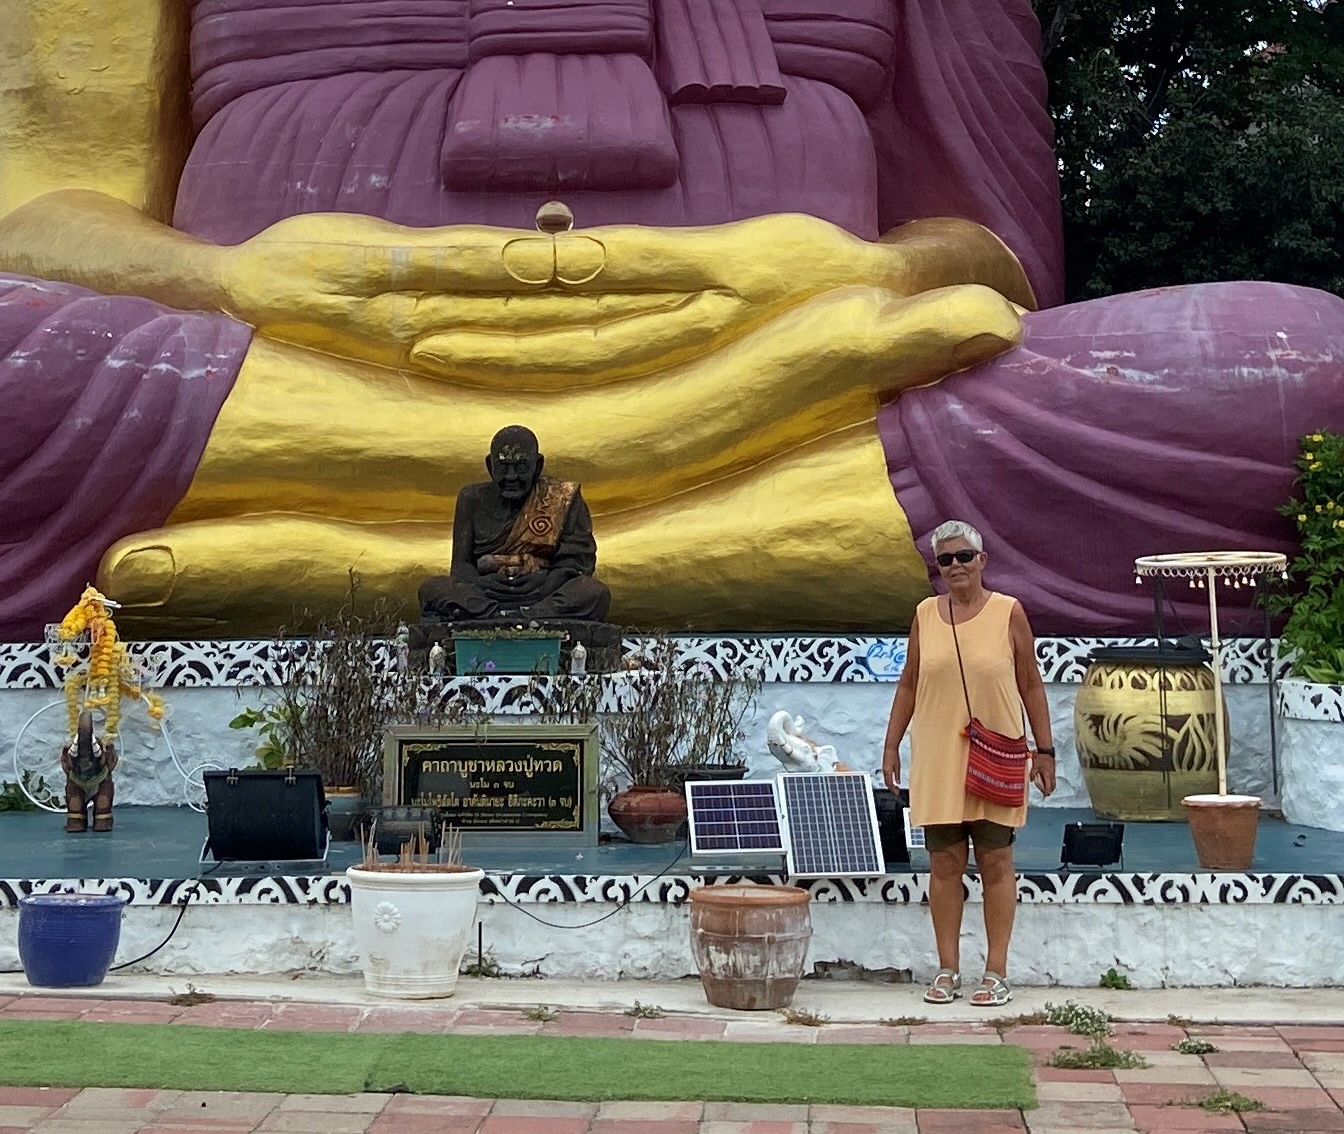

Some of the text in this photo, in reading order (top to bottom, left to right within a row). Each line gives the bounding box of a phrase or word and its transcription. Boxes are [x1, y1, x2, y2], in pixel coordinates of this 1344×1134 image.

[422, 755, 563, 778] คาถาบูชาหลวงปู่ทวด
[469, 777, 490, 788] นะโม
